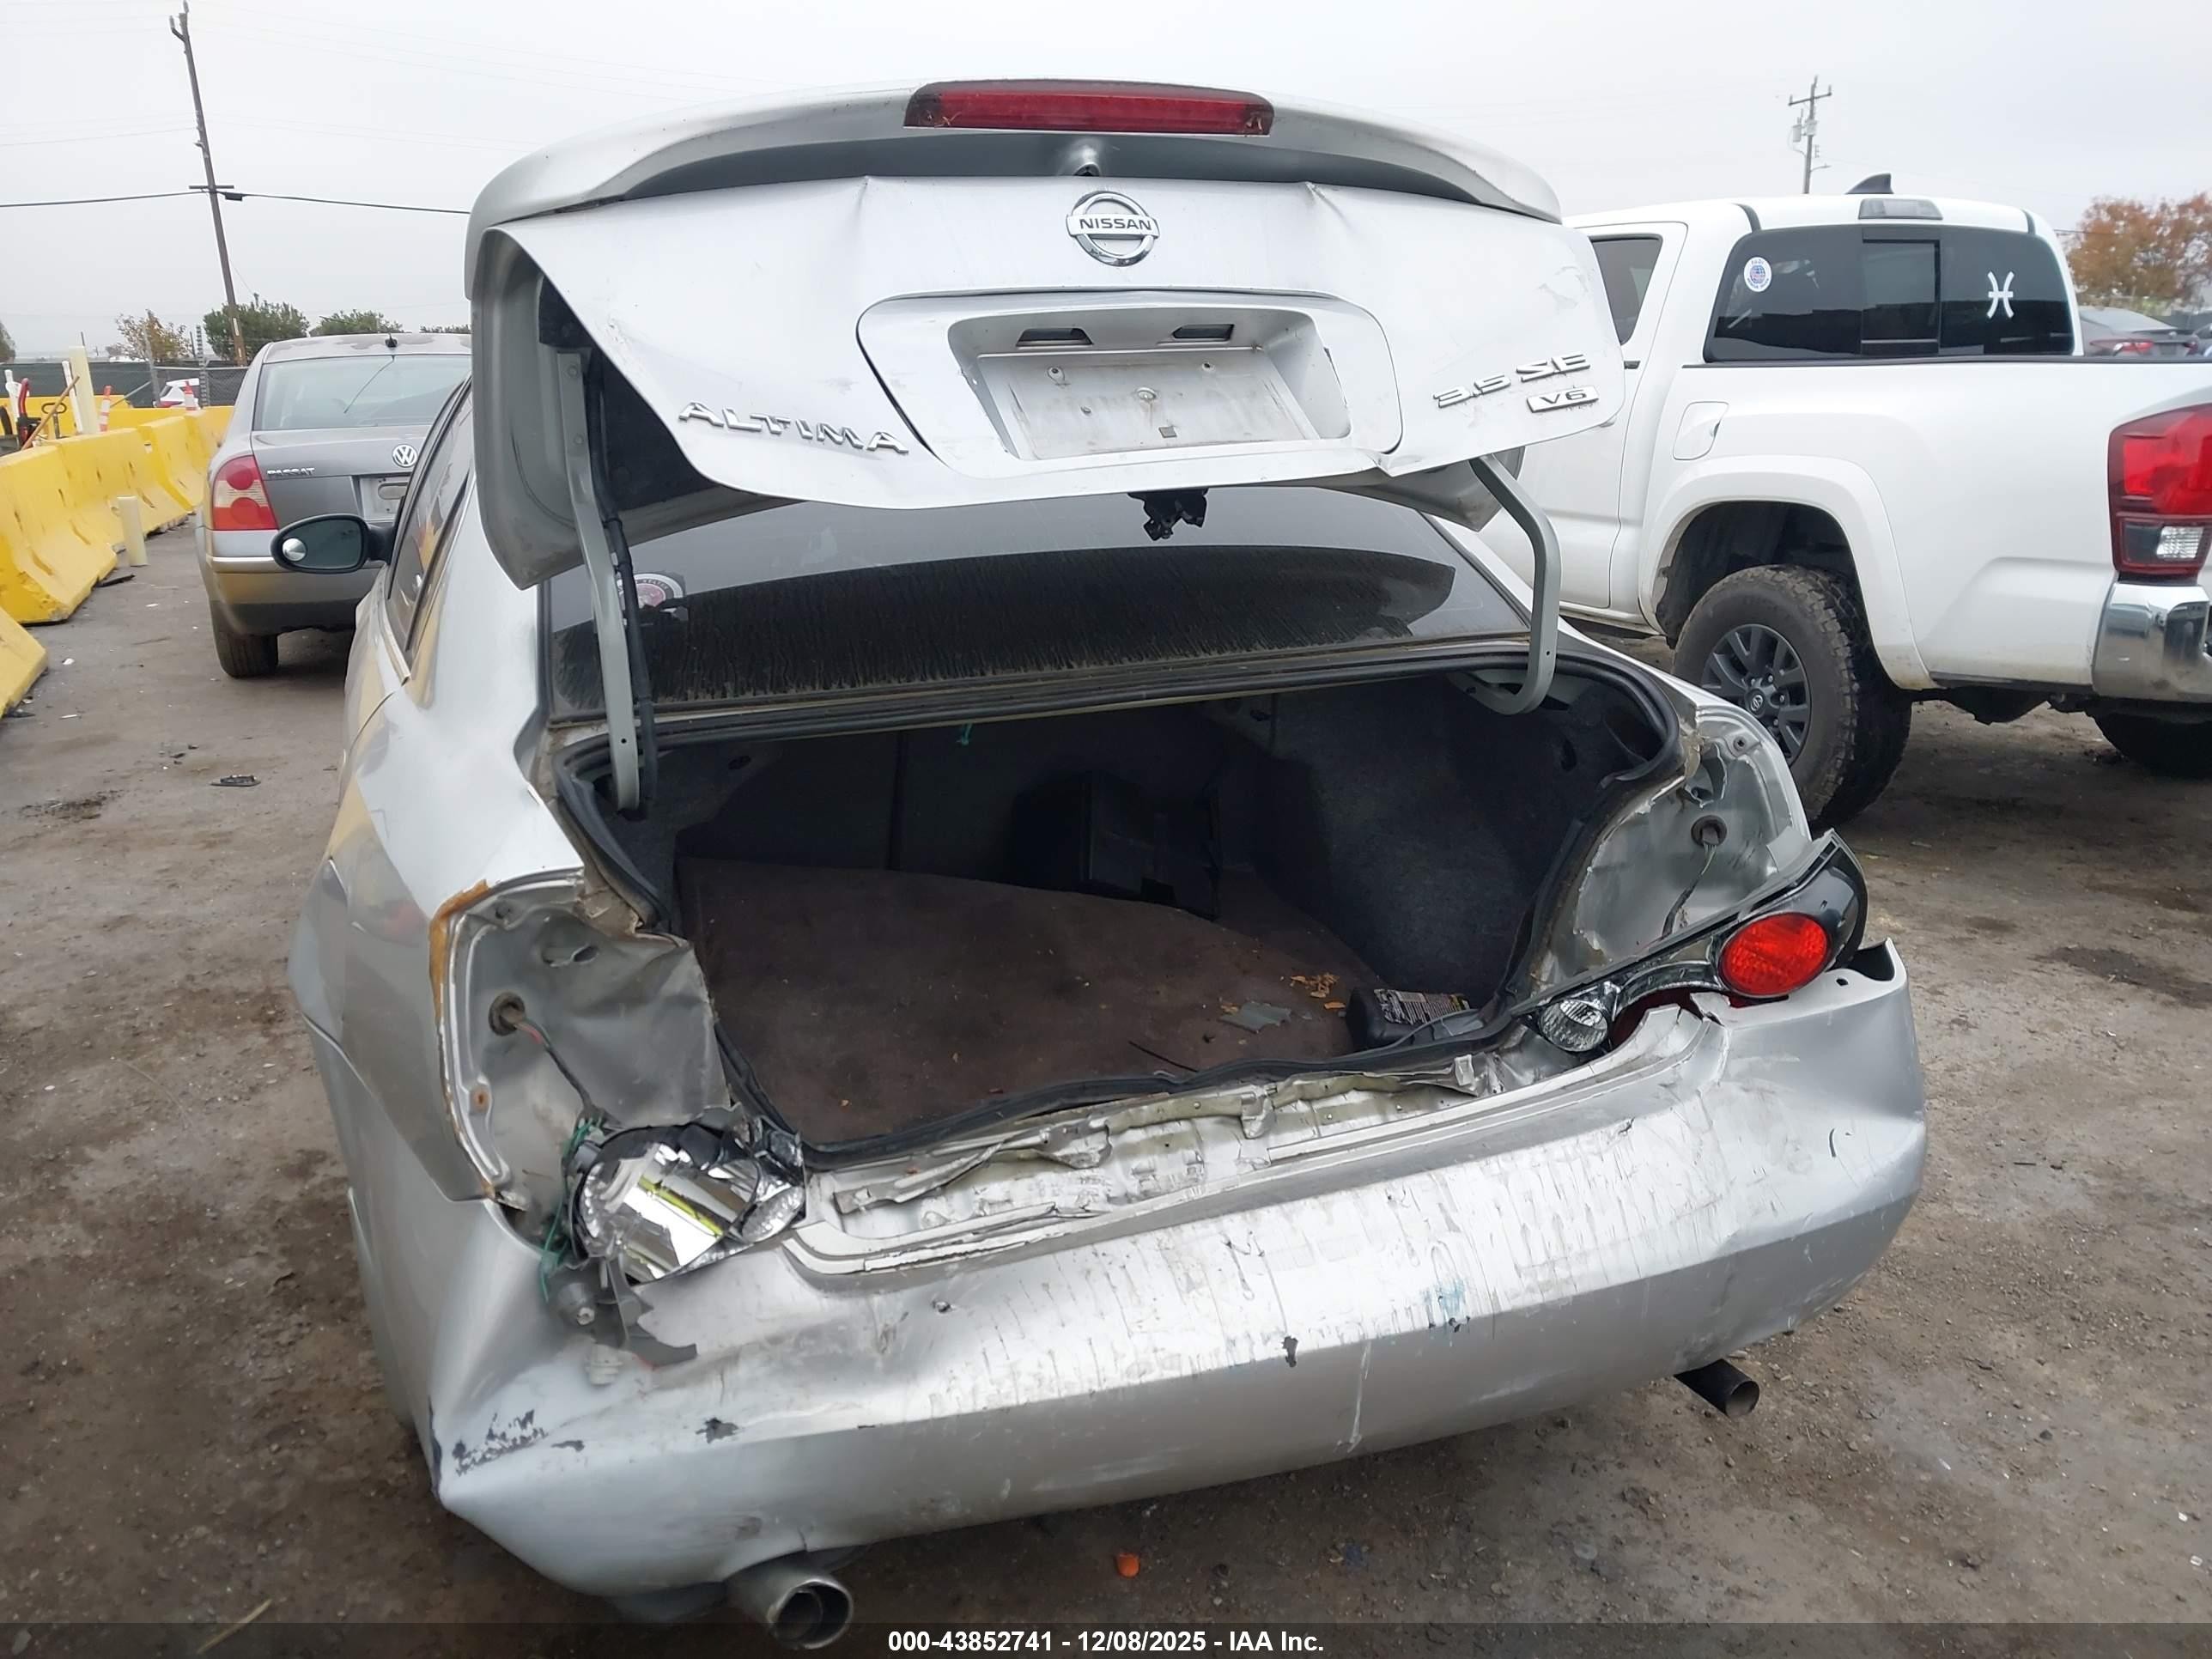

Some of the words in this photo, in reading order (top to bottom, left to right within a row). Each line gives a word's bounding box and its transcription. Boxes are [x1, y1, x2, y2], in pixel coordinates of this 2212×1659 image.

[1079, 218, 1152, 230] NISSAN
[1432, 374, 1511, 409] 3.5
[1516, 351, 1591, 383] SE
[1539, 388, 1588, 404] V6
[678, 401, 909, 454] ALTIMA
[266, 467, 316, 477] PASSAT
